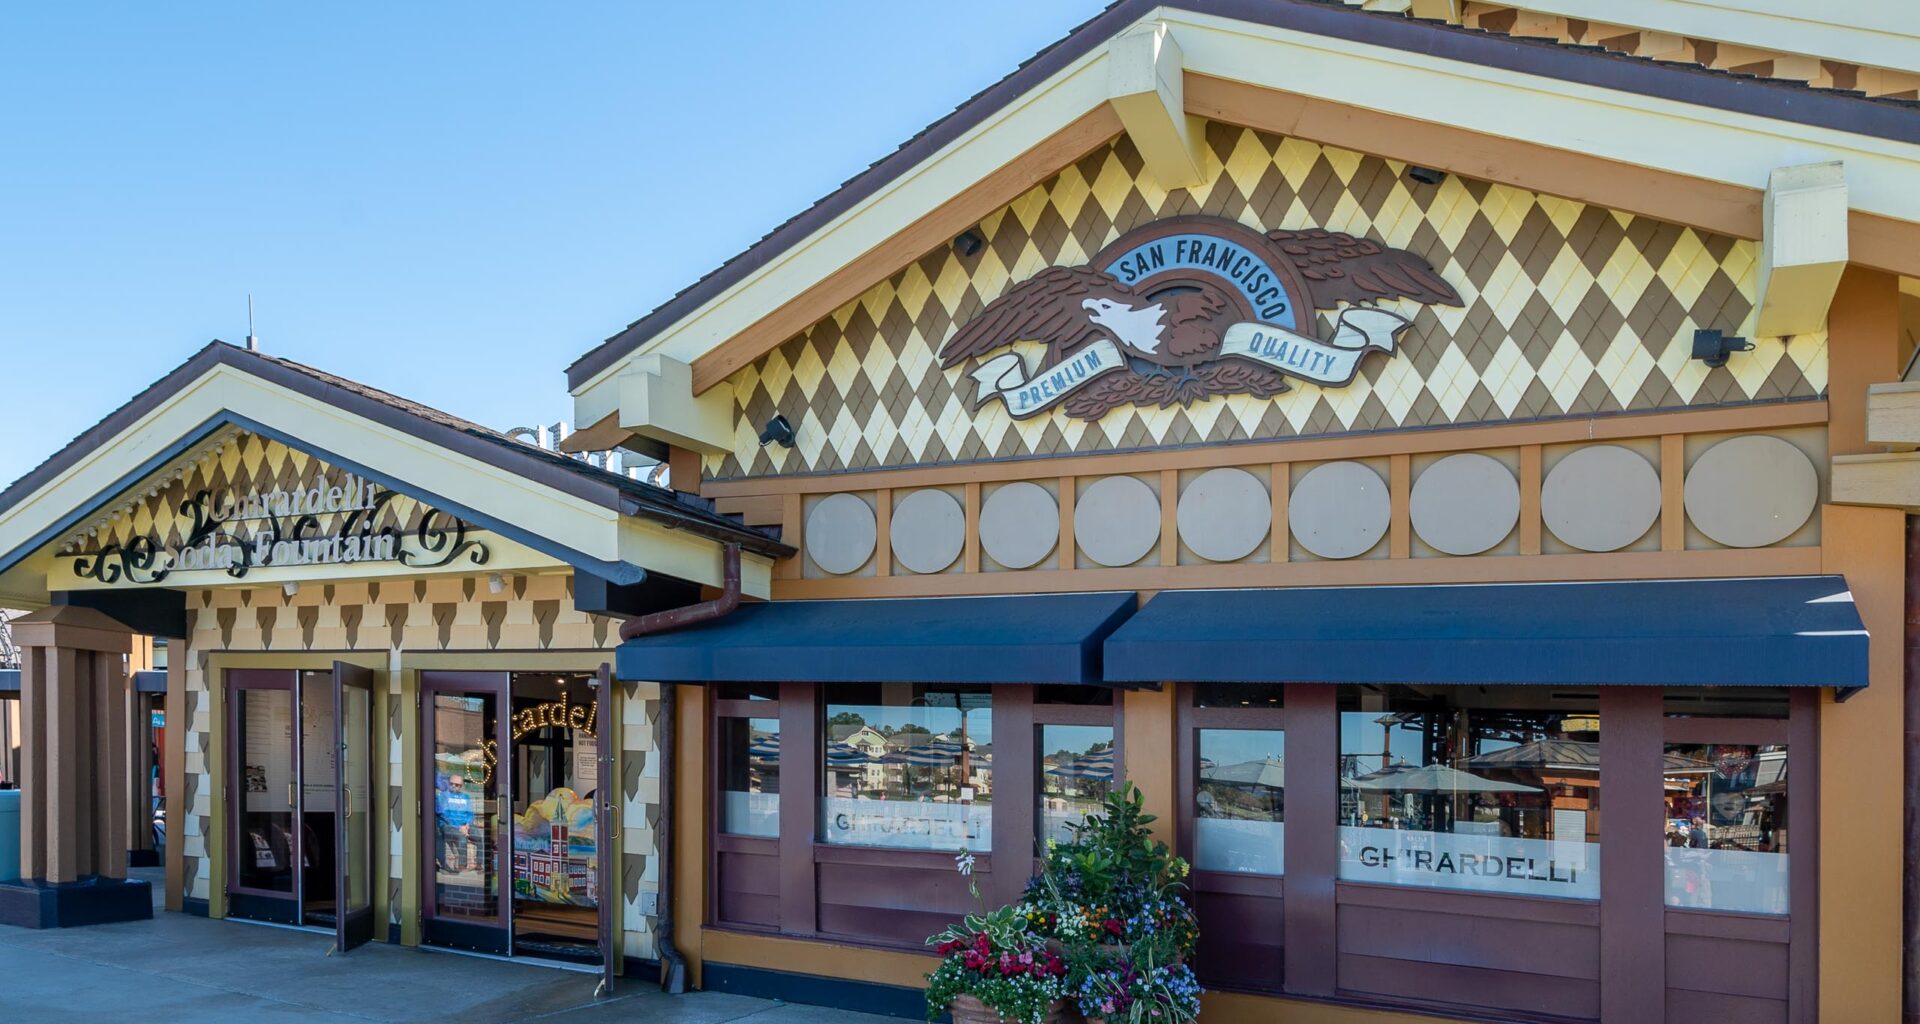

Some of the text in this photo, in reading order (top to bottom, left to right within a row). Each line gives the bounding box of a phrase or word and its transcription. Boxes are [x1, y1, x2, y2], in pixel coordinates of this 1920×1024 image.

[1119, 239, 1286, 320] SAN FRANCISCO
[1018, 331, 1337, 410] PREMIUM QUALITY
[208, 473, 376, 522] Ghirardelli
[164, 520, 395, 570] Soda Fountain
[1358, 846, 1578, 884] GHIRARDELLI
